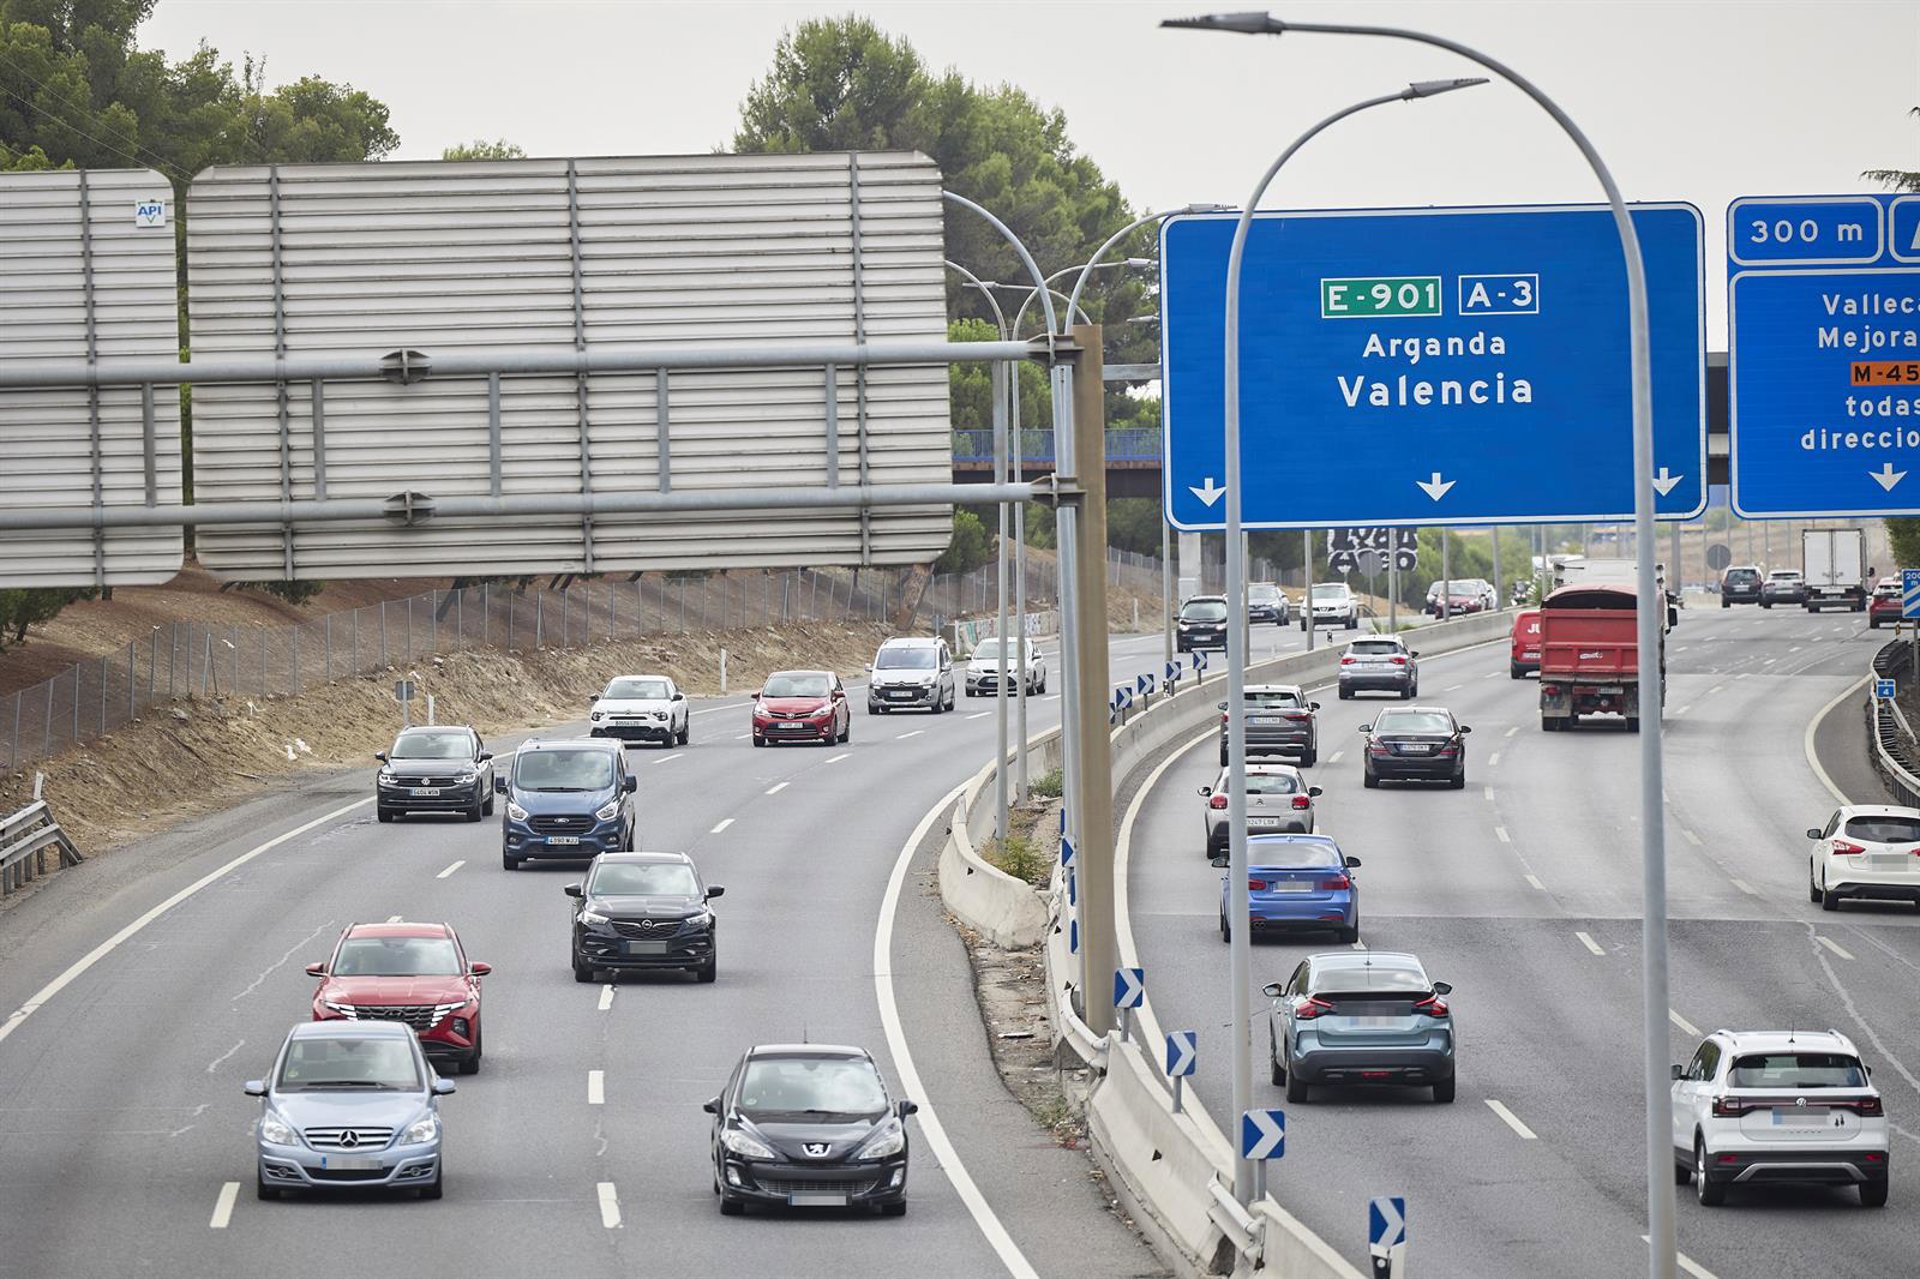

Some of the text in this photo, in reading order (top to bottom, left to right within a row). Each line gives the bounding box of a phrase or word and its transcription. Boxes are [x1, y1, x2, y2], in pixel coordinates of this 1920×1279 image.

[138, 206, 161, 215] API
[1751, 220, 1862, 243] 300 m
[1329, 283, 1435, 311] E-901
[1466, 280, 1532, 307] A-3
[1822, 294, 1920, 315] Vallec
[1363, 331, 1506, 365] Arganda
[1854, 364, 1919, 382] M-45
[1337, 373, 1532, 407] Valencia
